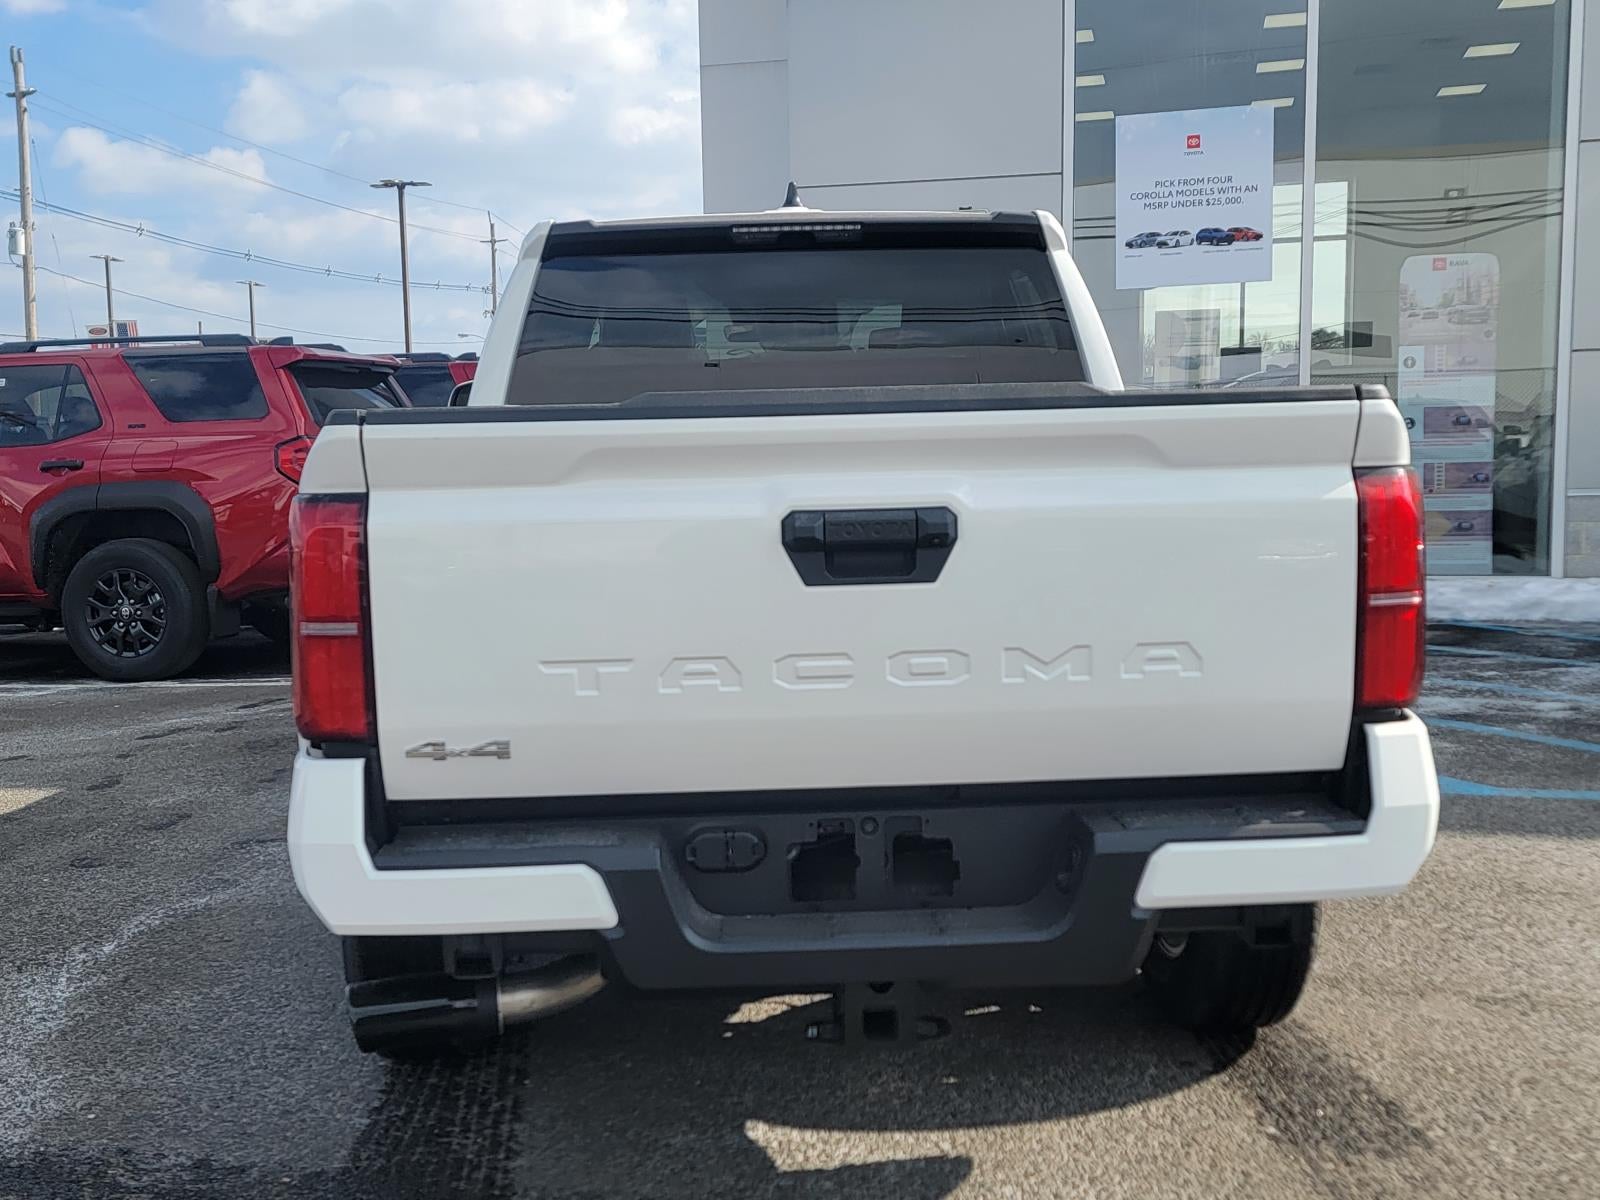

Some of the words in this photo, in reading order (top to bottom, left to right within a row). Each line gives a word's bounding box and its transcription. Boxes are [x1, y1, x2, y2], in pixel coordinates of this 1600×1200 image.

[1154, 180, 1176, 189] PICK
[1177, 178, 1205, 187] FROM
[1206, 175, 1233, 185] FOUR
[1130, 191, 1174, 201] COROLLA
[1175, 188, 1215, 198] MODELS
[1217, 185, 1242, 195] WITH
[1244, 184, 1258, 193] AN
[1143, 202, 1169, 211] MSRP
[1170, 199, 1203, 209] UNDER
[1206, 196, 1244, 207] $25,000.
[829, 520, 914, 539] TOYOTA
[537, 640, 1204, 697] TACOMA
